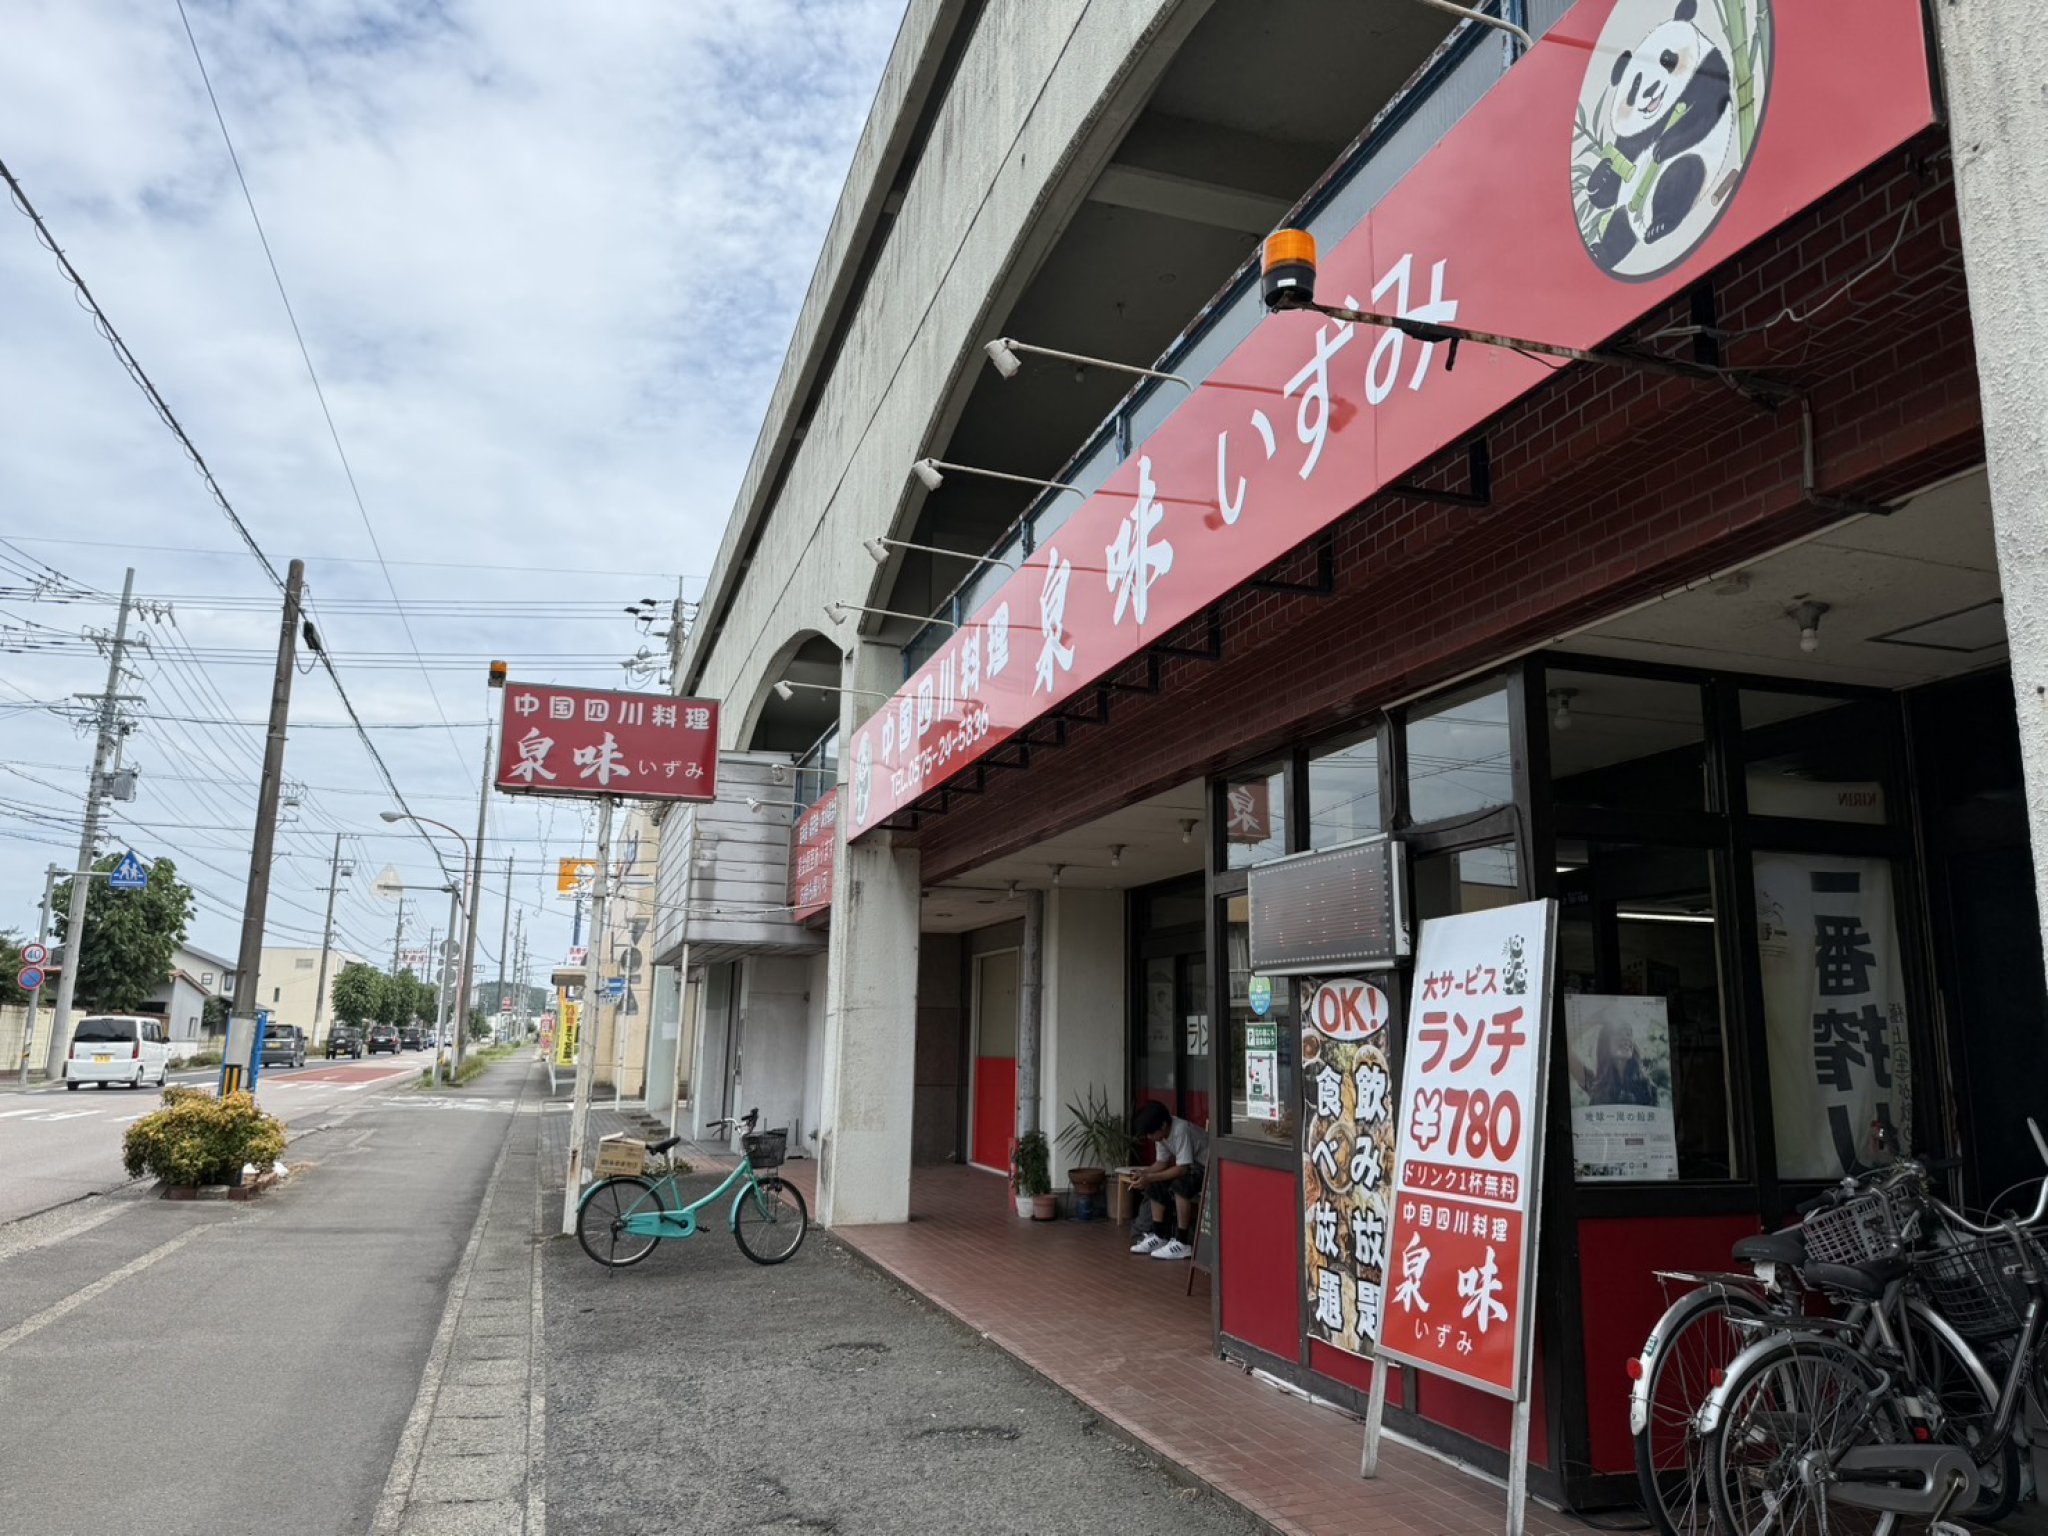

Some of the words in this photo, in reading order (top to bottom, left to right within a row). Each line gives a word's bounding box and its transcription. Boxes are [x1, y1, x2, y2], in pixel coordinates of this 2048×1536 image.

[881, 601, 1009, 764] 中国四川料理
[1032, 455, 1174, 697] 泉味
[1217, 253, 1459, 525] いずみ
[514, 692, 711, 730] 中国四川料理
[506, 727, 631, 785] 泉味
[638, 760, 704, 779] いずみ
[27, 950, 40, 959] 40
[1422, 966, 1498, 1001] 大サービス
[1317, 986, 1380, 1034] OK!
[1417, 1005, 1527, 1077] ランチ
[1410, 1087, 1521, 1163] ¥780
[1312, 1065, 1344, 1333] 食べ放題
[1404, 1161, 1516, 1199] ドリンク1杯無料
[1402, 1203, 1509, 1243] 中国四川料理
[1392, 1230, 1509, 1334] 泉味
[1414, 1316, 1474, 1355] いずみ
